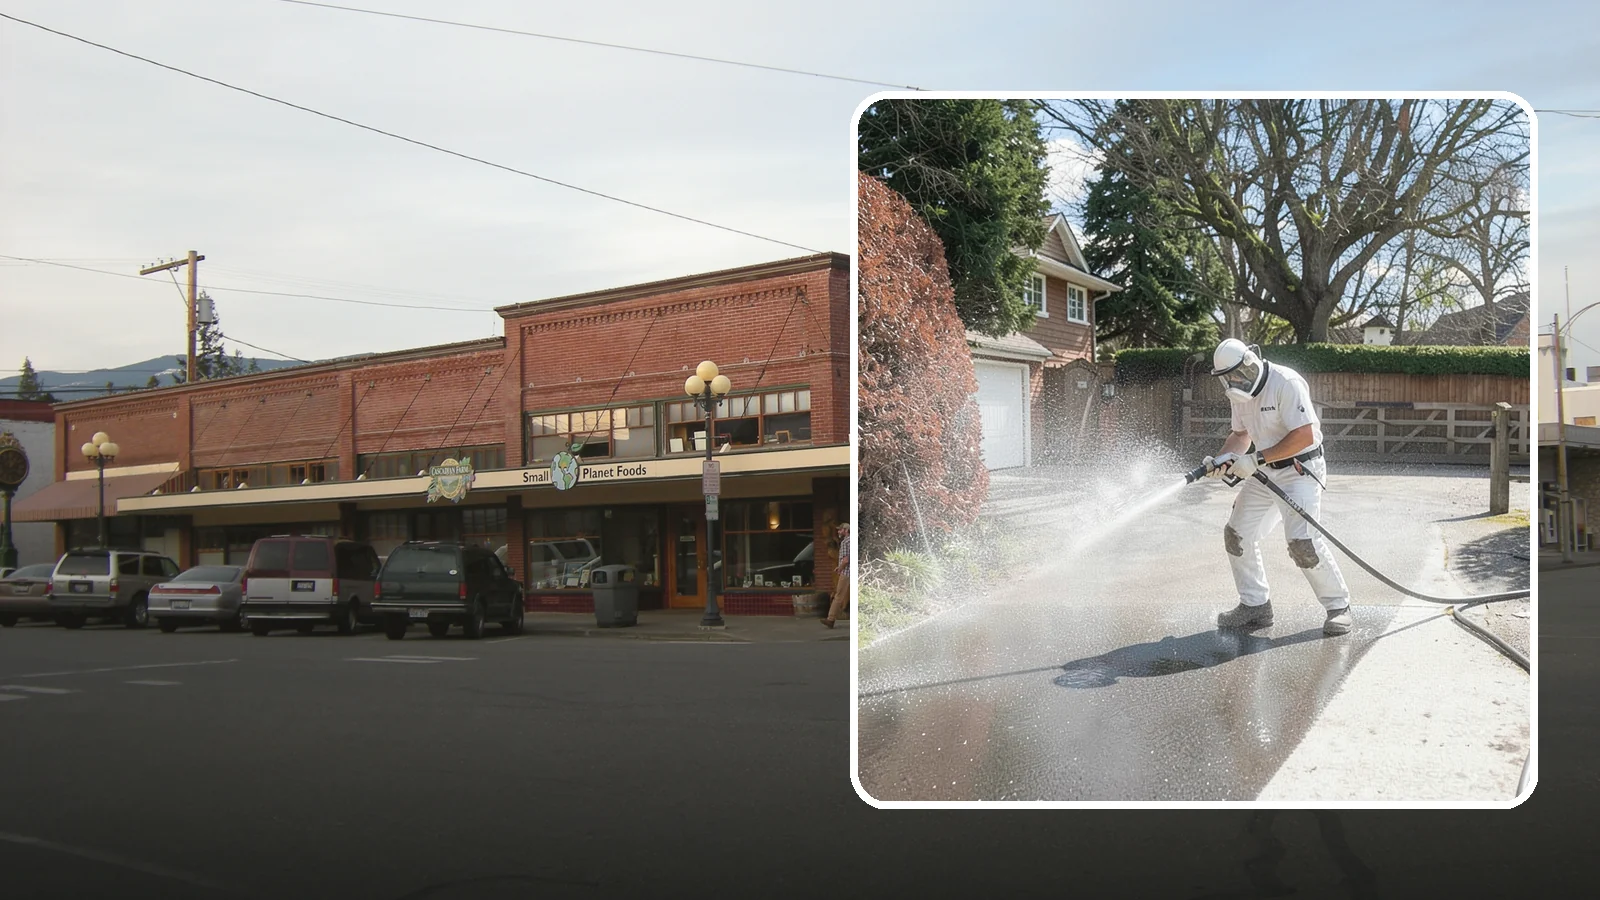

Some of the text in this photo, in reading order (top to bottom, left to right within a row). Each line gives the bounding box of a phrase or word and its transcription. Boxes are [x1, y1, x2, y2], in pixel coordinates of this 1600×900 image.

[523, 464, 647, 483] Small Planet Foods
